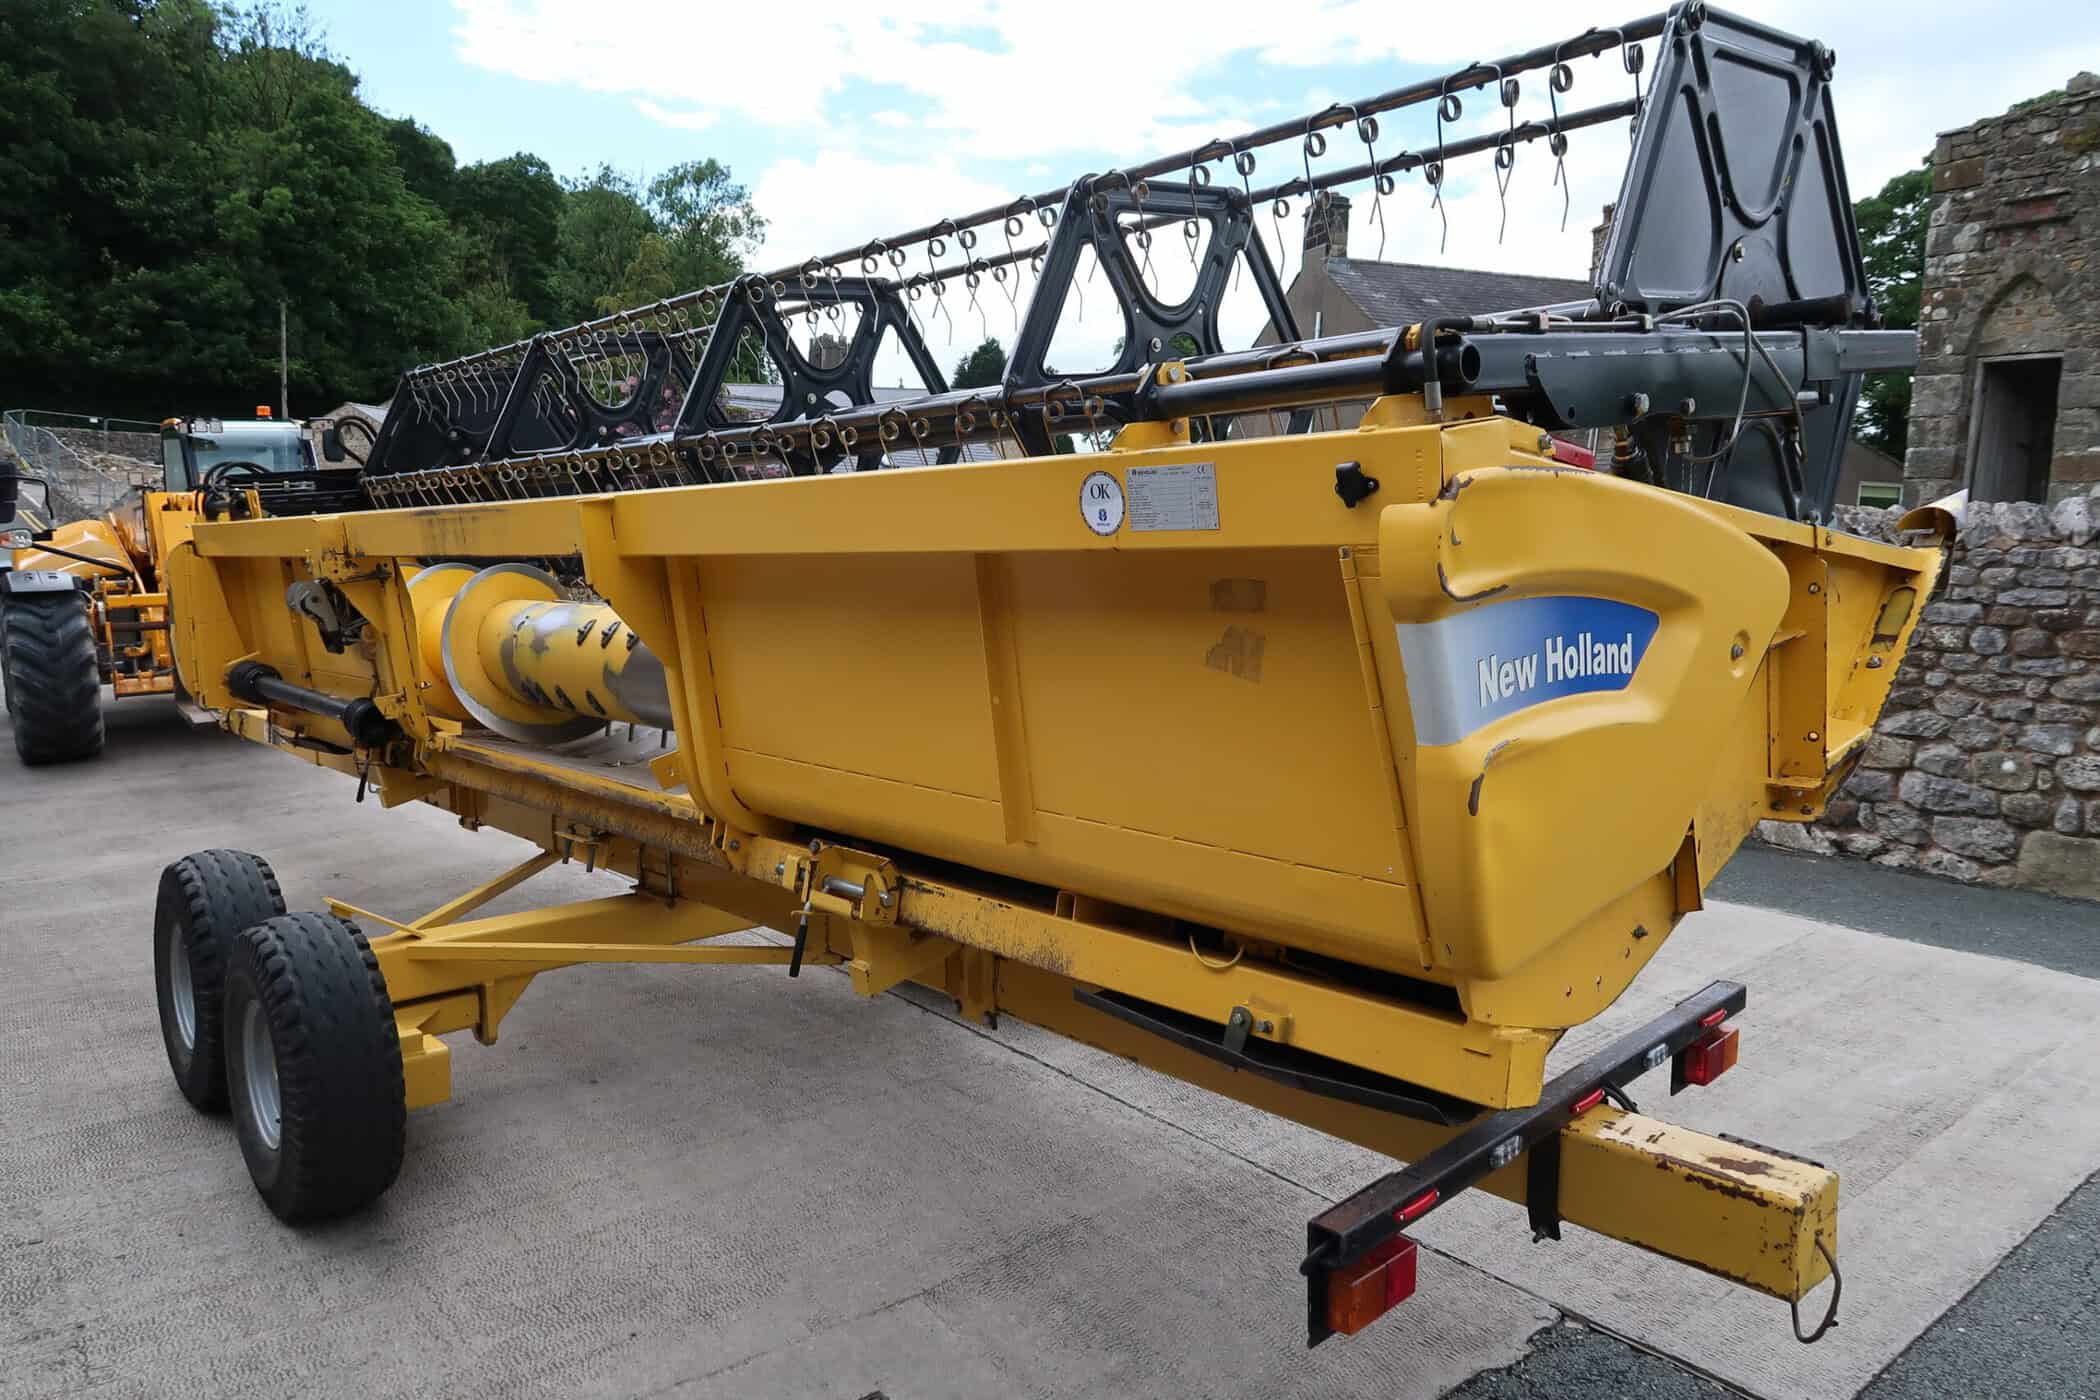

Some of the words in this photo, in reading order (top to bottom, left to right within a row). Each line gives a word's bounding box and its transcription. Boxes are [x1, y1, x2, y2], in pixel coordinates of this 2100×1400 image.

[1090, 483, 1111, 500] OK
[1476, 653, 1538, 709] New
[1544, 631, 1633, 684] Holland
